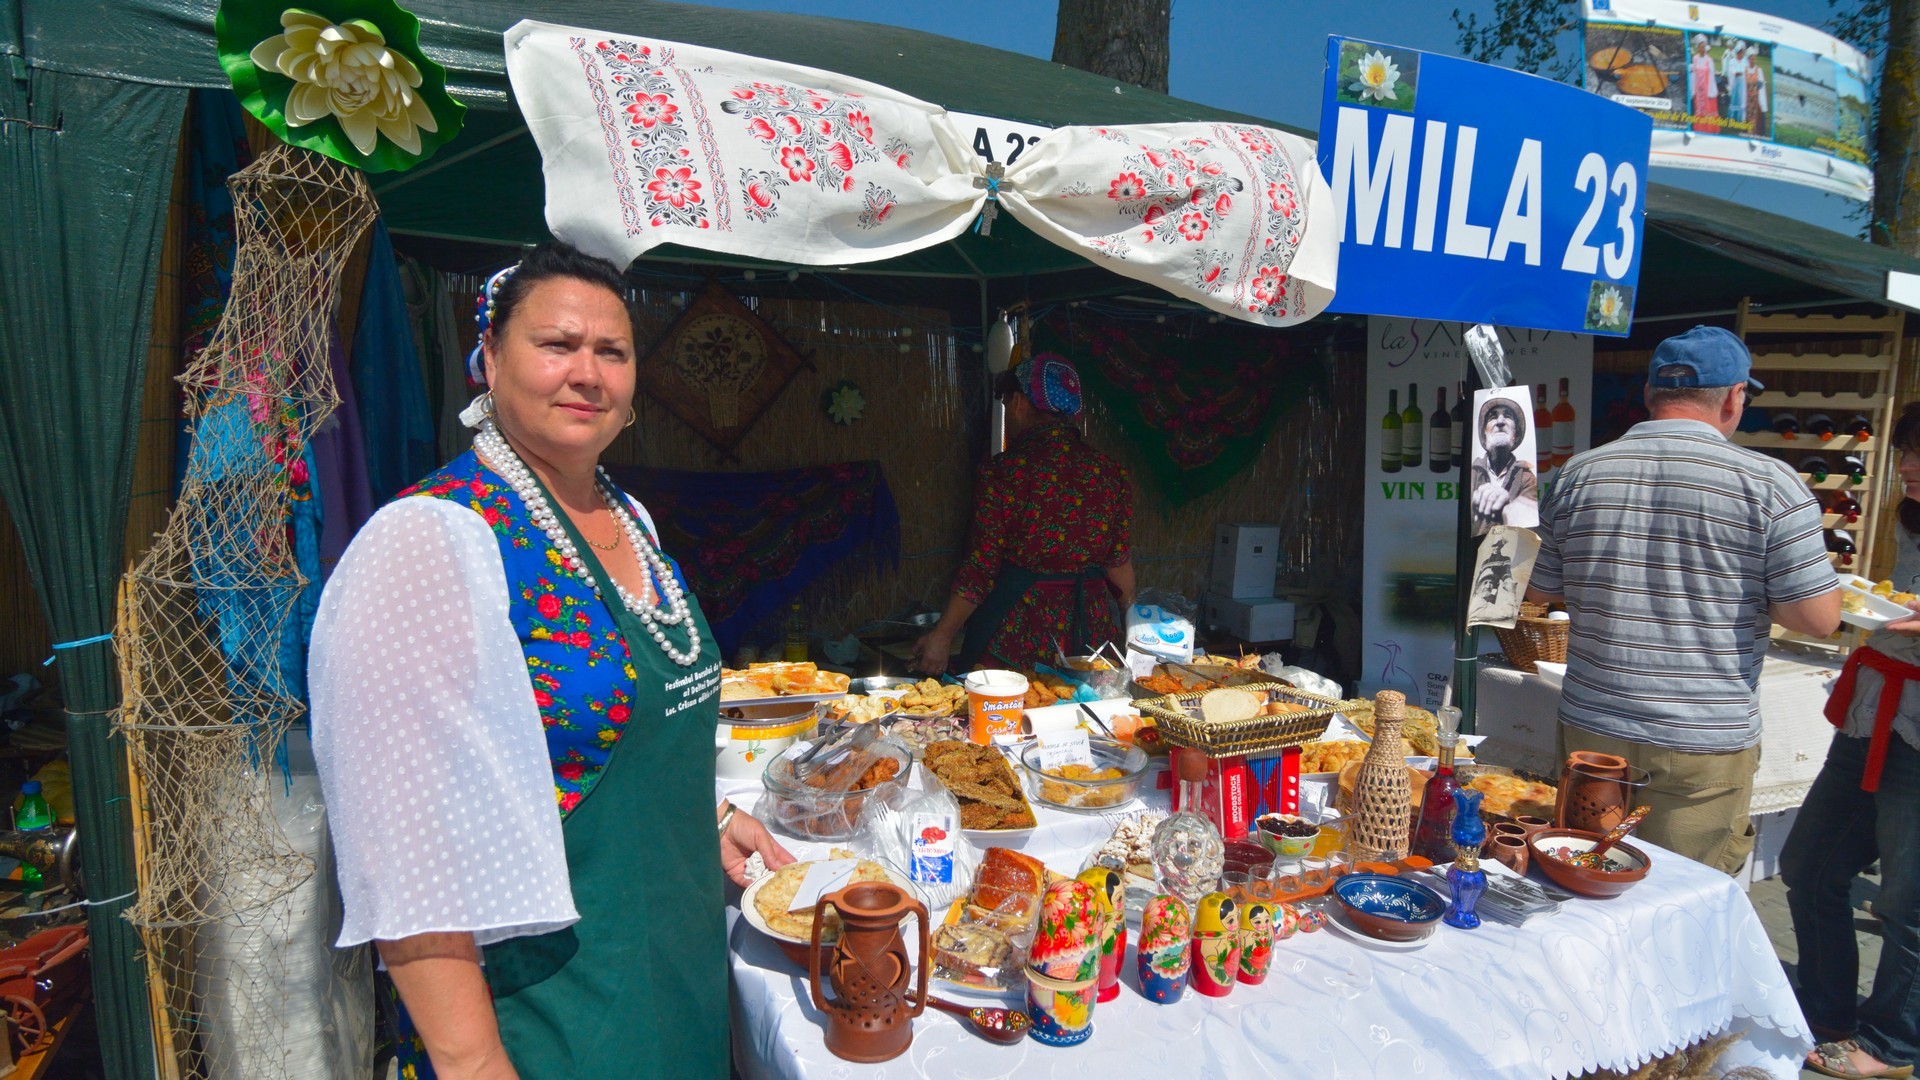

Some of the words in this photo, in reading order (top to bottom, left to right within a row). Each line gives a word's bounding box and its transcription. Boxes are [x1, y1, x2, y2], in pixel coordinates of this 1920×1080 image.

[1330, 105, 1542, 267] MILA
[1561, 151, 1638, 280] 23
[1380, 481, 1426, 500] VIN
[682, 687, 690, 698] al
[1229, 774, 1239, 824] WOODSTOCK
